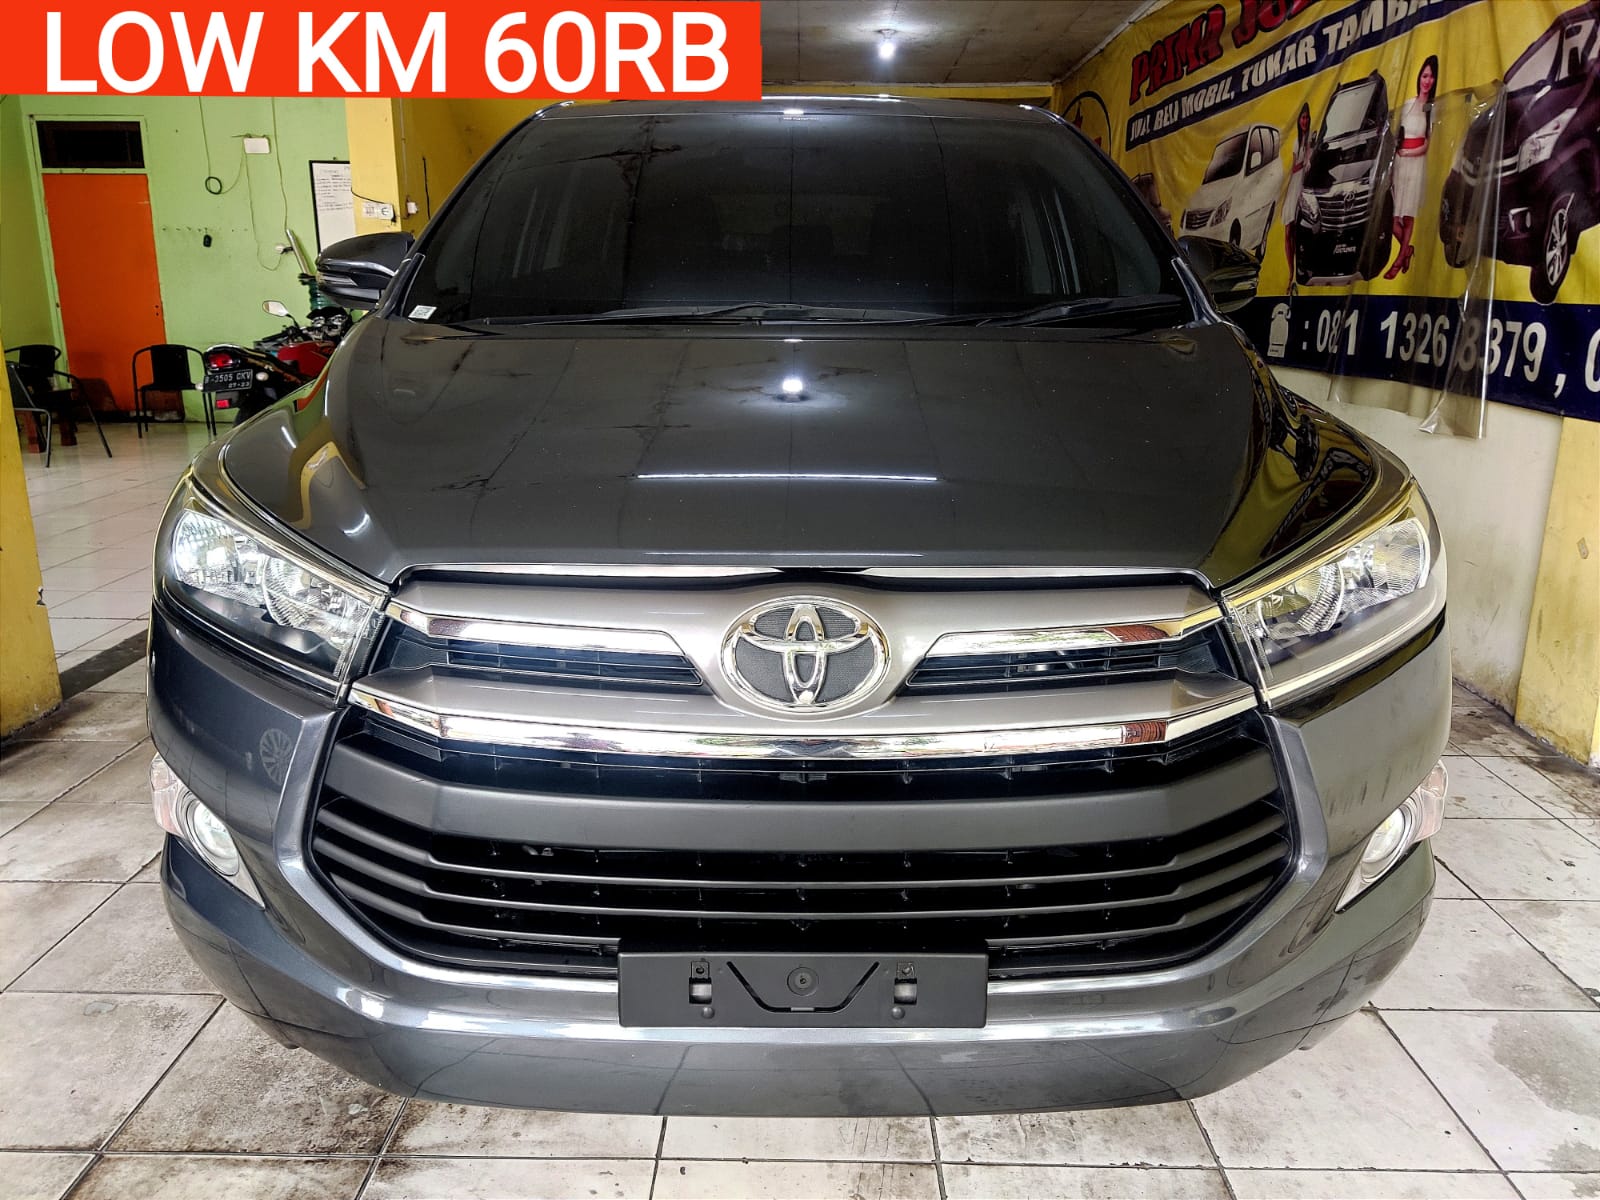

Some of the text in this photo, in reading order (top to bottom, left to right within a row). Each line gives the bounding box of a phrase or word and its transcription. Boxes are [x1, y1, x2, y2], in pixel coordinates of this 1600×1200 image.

[1153, 100, 1179, 131] BELI
[1181, 76, 1235, 119] MOBIL,
[1241, 35, 1317, 92] TUKAR
[1322, 0, 1443, 55] TAMB
